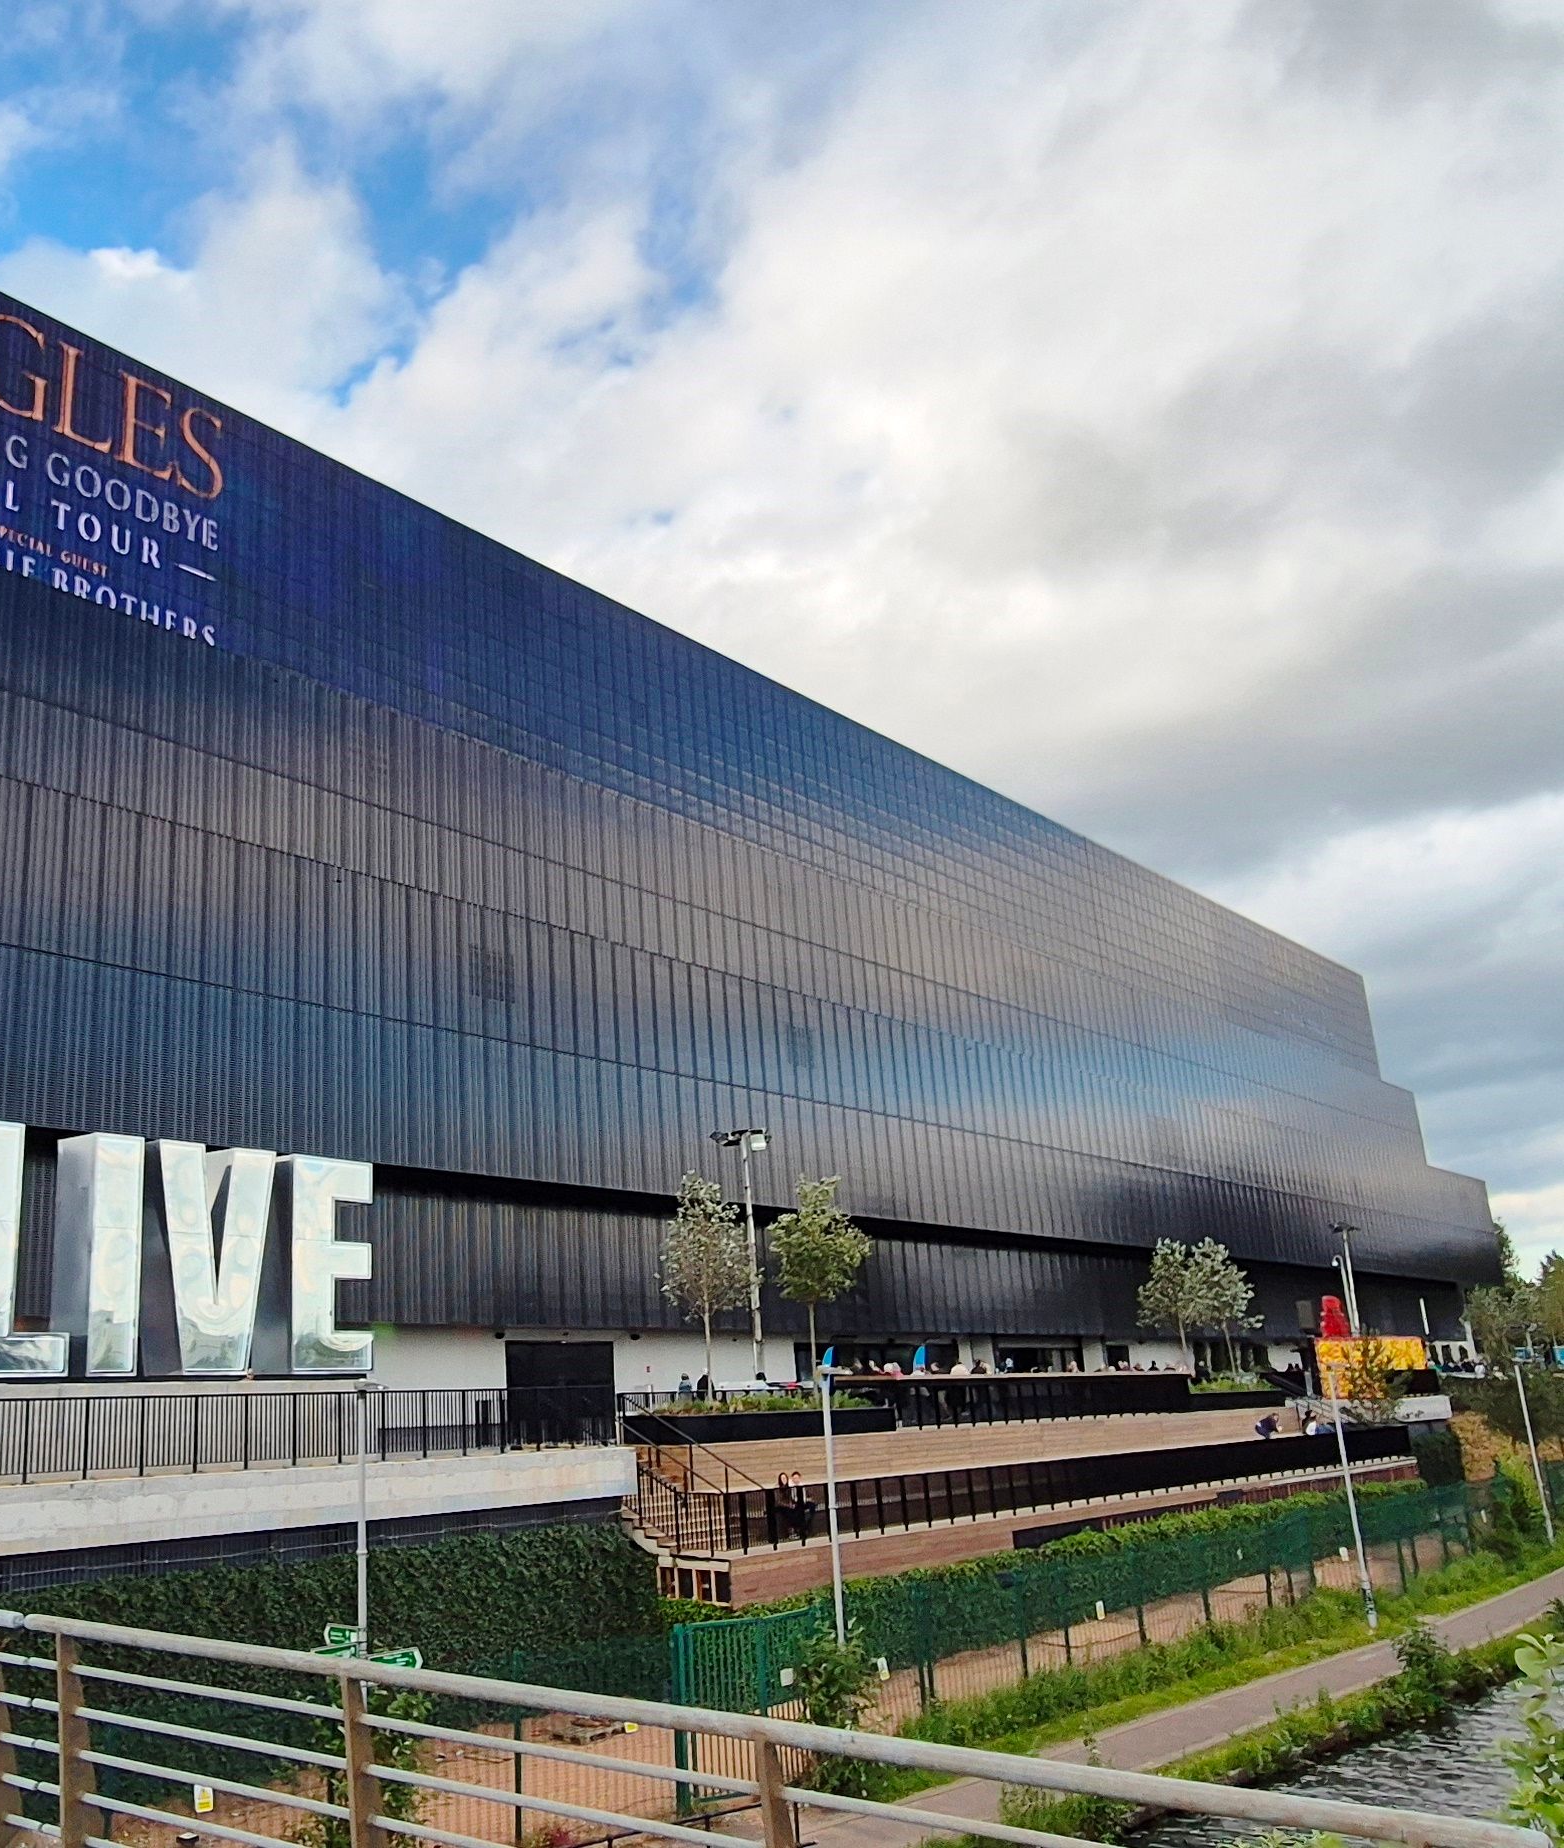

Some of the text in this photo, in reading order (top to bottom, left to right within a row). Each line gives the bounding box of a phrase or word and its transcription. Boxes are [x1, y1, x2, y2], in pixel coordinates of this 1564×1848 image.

[45, 451, 219, 552] GOODBYE
[50, 499, 161, 569] TOUR
[60, 550, 109, 579] GUEST
